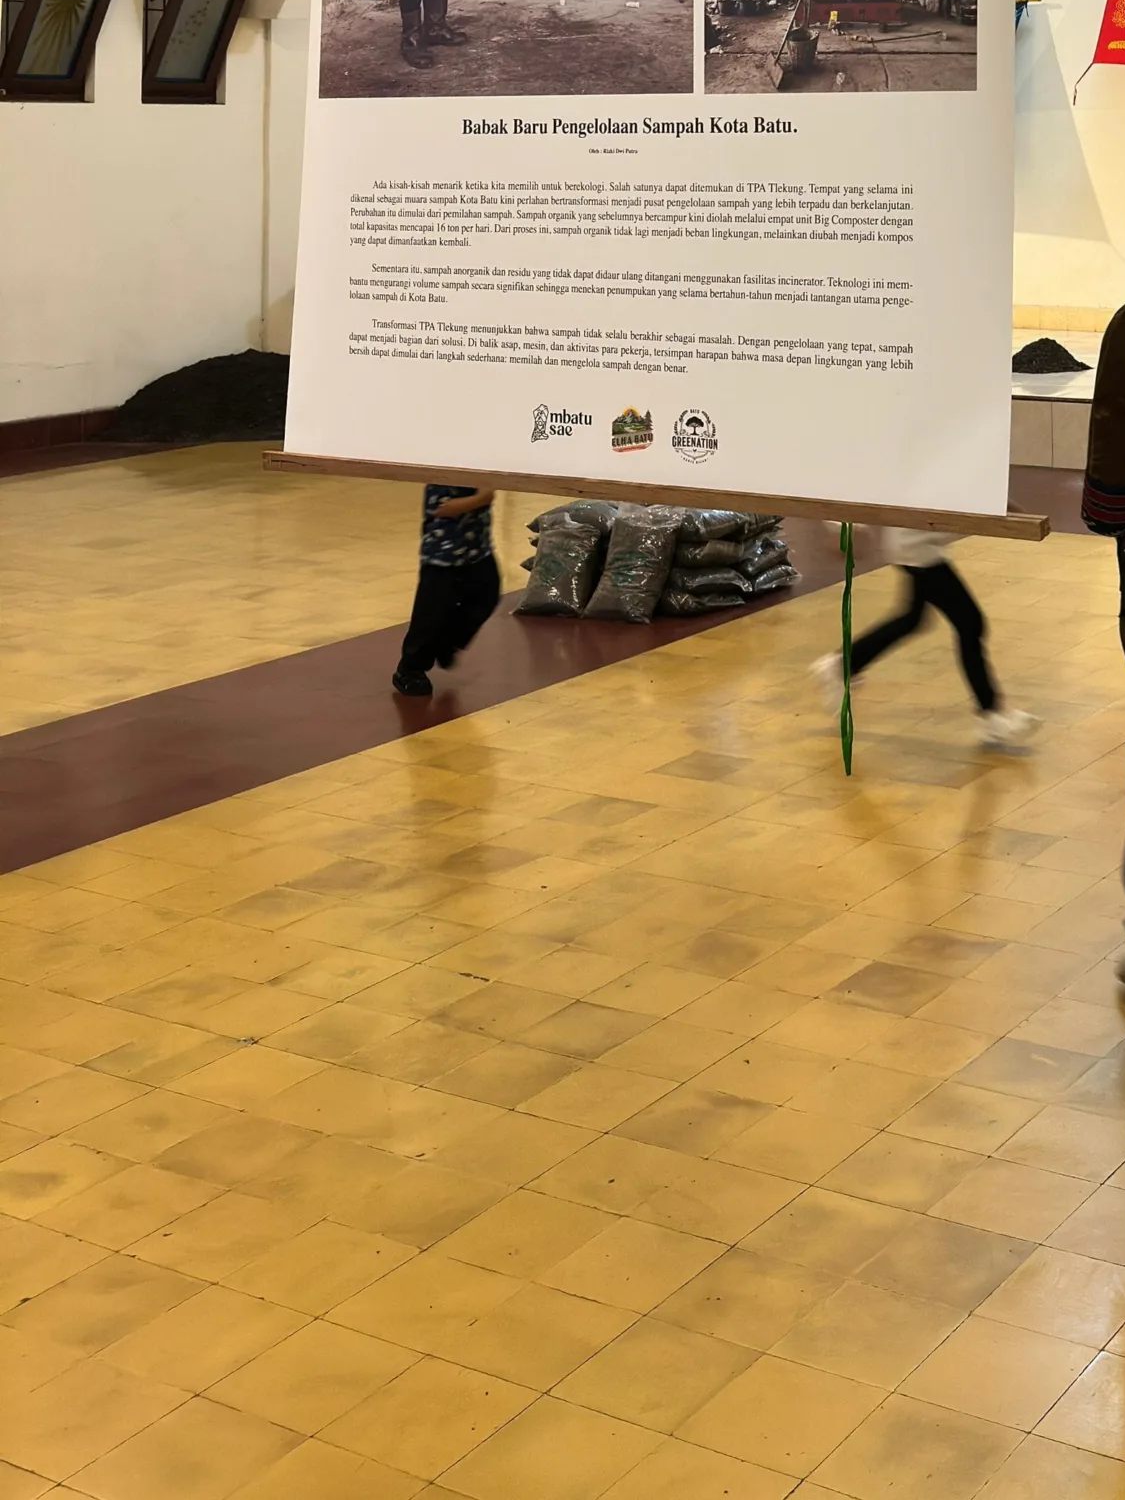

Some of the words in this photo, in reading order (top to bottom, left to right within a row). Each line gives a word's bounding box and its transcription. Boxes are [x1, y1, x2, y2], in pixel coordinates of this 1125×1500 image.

[462, 119, 508, 134] Babak
[512, 118, 547, 134] Baru
[552, 118, 637, 137] Pengelolaan
[642, 117, 704, 137] Sampah
[709, 117, 748, 133] Kota
[753, 116, 797, 132] Batu.
[372, 180, 387, 189] Ada
[389, 180, 430, 189] kisah-kisah
[432, 180, 463, 189] menarik
[465, 180, 489, 189] ketika
[490, 180, 505, 190] kita
[507, 181, 539, 190] memilih
[541, 181, 562, 190] untuk
[564, 181, 607, 193] berekologi.
[609, 181, 630, 191] Salah
[633, 184, 663, 193] satunya
[664, 182, 687, 194] dapat
[689, 182, 733, 192] ditemukan
[735, 182, 744, 192] di
[746, 182, 766, 192] TPA
[767, 182, 806, 195] Tlekung.
[808, 183, 840, 195] Tempat
[842, 186, 864, 196] yang
[866, 184, 898, 194] selama
[901, 184, 913, 194] ini
[350, 193, 375, 202] dikenal
[376, 194, 402, 205] sebagai
[428, 194, 458, 206] sampah
[459, 194, 478, 204] Kota
[480, 194, 498, 204] Batu
[499, 195, 515, 204] kini
[516, 195, 549, 206] perlahan
[550, 196, 609, 205] bertransformasi
[611, 196, 641, 208] menjadi
[643, 199, 664, 208] pusat
[666, 197, 715, 209] pengelolaan
[717, 198, 750, 209] sampah
[751, 200, 773, 210] yang
[775, 198, 796, 208] lebih
[798, 199, 830, 210] terpadu
[832, 199, 848, 209] dan
[850, 199, 913, 212] berkelanjutan.
[350, 207, 386, 216] Perubahan
[387, 208, 396, 217] itu
[397, 208, 425, 217] dimulai
[426, 208, 441, 217] dari
[442, 209, 482, 219] pemilahan
[483, 209, 515, 220] sampah.
[516, 209, 546, 221] Sampah
[547, 210, 576, 221] organik
[577, 213, 596, 222] yang
[597, 211, 643, 223] sebelumnya
[644, 212, 687, 223] bercampur
[688, 212, 704, 222] kini
[706, 212, 732, 222] diolah
[734, 213, 766, 223] melalui
[767, 215, 794, 226] empat
[795, 214, 812, 223] unit
[814, 214, 830, 226] Big
[831, 214, 879, 227] Composter
[880, 215, 913, 228] dengan
[349, 221, 365, 230] total
[366, 221, 398, 232] kapasitas
[399, 223, 434, 233] mencapai
[436, 222, 446, 232] 16
[447, 224, 459, 232] ton
[460, 225, 474, 234] per
[475, 223, 492, 232] hari.
[494, 223, 511, 232] Dari
[512, 226, 537, 235] proses
[538, 224, 551, 234] ini,
[552, 225, 581, 236] sampah
[583, 225, 612, 237] organik
[613, 225, 633, 235] tidak
[634, 226, 649, 238] lagi
[651, 227, 683, 238] menjadi
[684, 227, 709, 237] beban
[711, 227, 762, 240] lingkungan,
[763, 229, 807, 239] melainkan
[809, 229, 838, 239] diubah
[840, 230, 875, 242] menjadi
[877, 231, 913, 243] kompos
[349, 237, 366, 246] yang
[367, 235, 386, 246] dapat
[388, 236, 437, 245] dimanfaatkan
[438, 237, 471, 246] kembali.
[371, 263, 408, 273] Sementara
[410, 264, 422, 273] itu,
[423, 265, 451, 276] sampah
[453, 266, 490, 277] anorganik
[491, 266, 505, 276] dan
[507, 267, 530, 276] residu
[532, 270, 551, 280] yang
[552, 268, 571, 278] tidak
[572, 269, 593, 280] dapat
[595, 270, 620, 279] didaur
[621, 271, 643, 283] ulang
[644, 271, 681, 284] ditangani
[683, 274, 741, 285] menggunakan
[743, 274, 776, 284] fasilitas
[777, 275, 825, 286] incinerator.
[826, 276, 870, 289] Teknologi
[872, 278, 884, 288] ini
[886, 281, 913, 289] mem-
[349, 290, 370, 299] lolaan
[371, 292, 398, 302] sampah
[399, 292, 406, 301] di
[408, 292, 426, 301] Kota
[428, 293, 447, 302] Batu.
[550, 409, 592, 426] mbatu
[550, 423, 573, 436] sae
[672, 435, 718, 450] GREENATION
